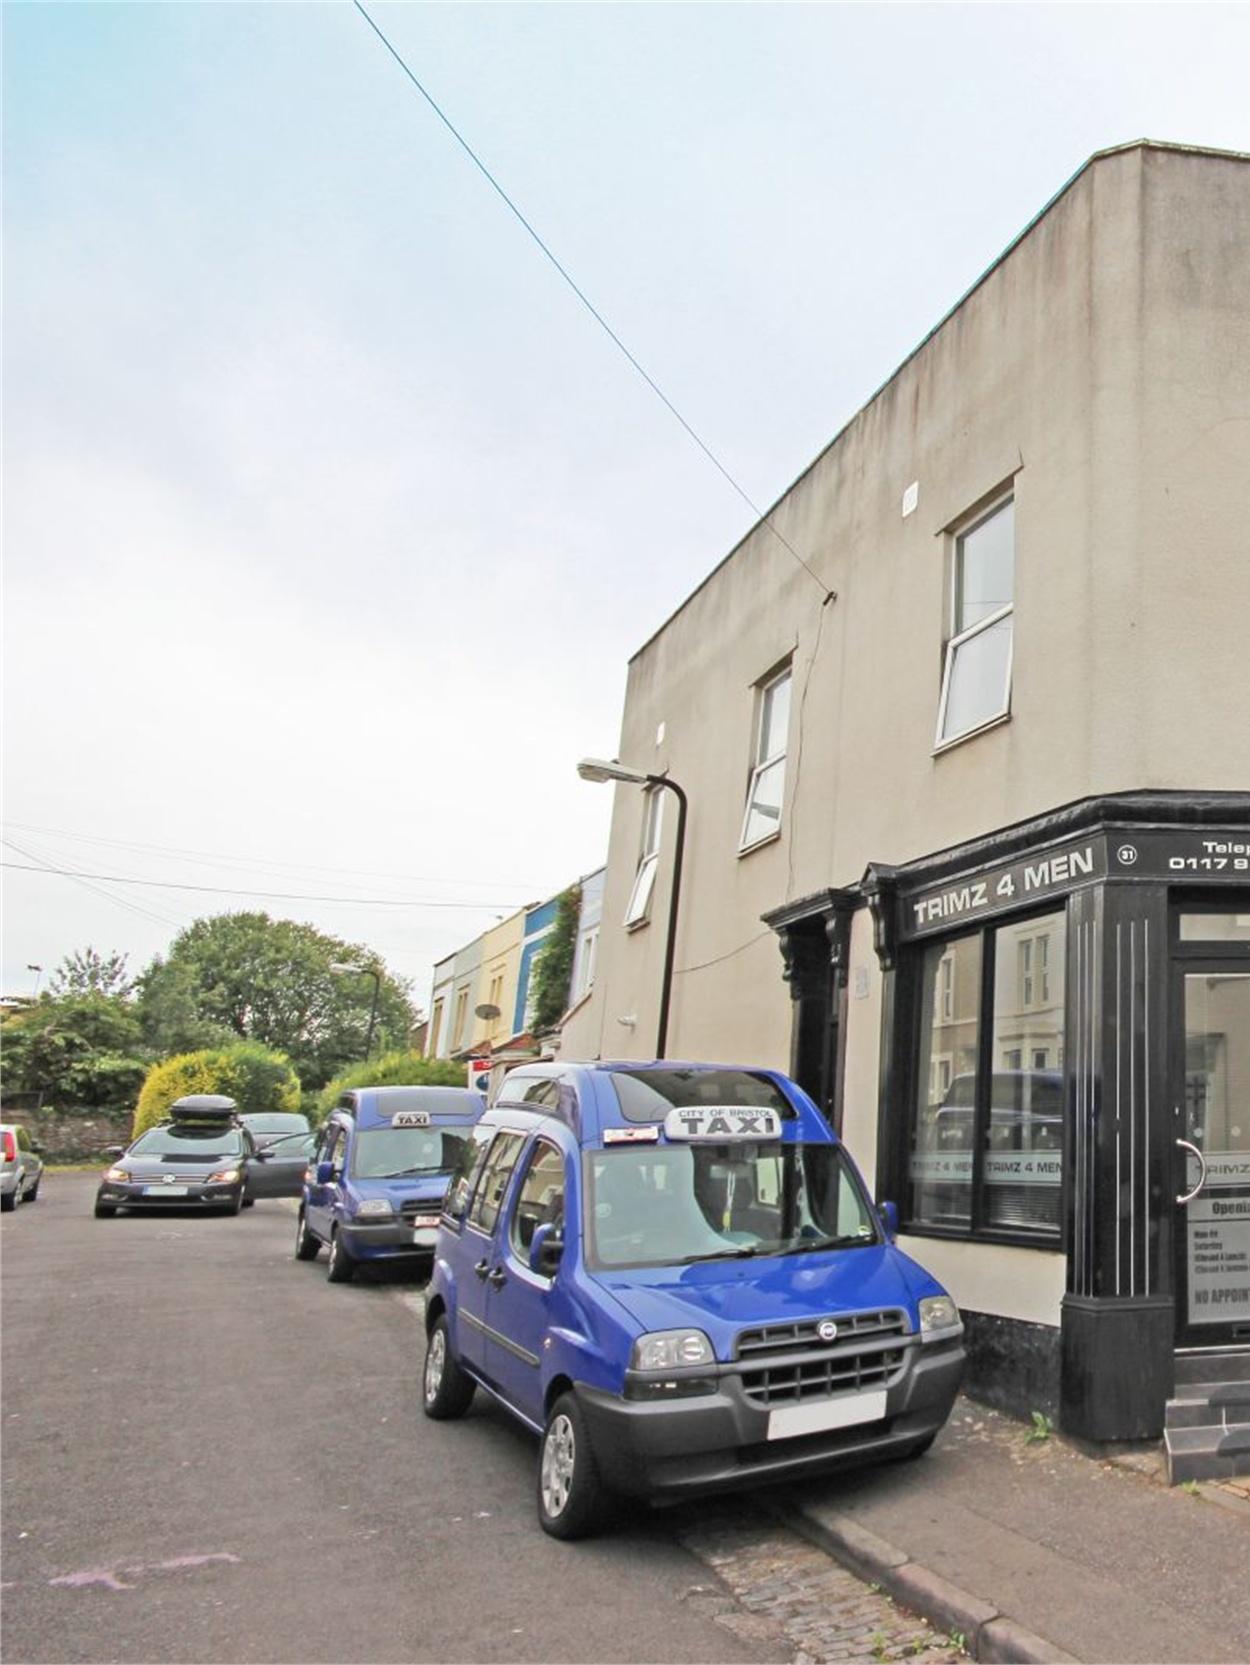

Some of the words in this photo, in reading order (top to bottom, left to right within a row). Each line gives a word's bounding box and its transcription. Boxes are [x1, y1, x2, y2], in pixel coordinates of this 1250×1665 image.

[1169, 858, 1228, 870] 0117
[914, 883, 988, 923] TRIMZ
[996, 873, 1014, 897] 4
[1024, 847, 1093, 891] MEN
[398, 1115, 427, 1124] TAXI
[680, 1110, 704, 1118] CITY
[709, 1109, 725, 1117] OF
[729, 1109, 773, 1118] BRISTOL
[680, 1117, 775, 1135] TAXI
[986, 1161, 1021, 1173] TRIMZ
[1024, 1162, 1033, 1172] 4
[1195, 1289, 1209, 1304] NO
